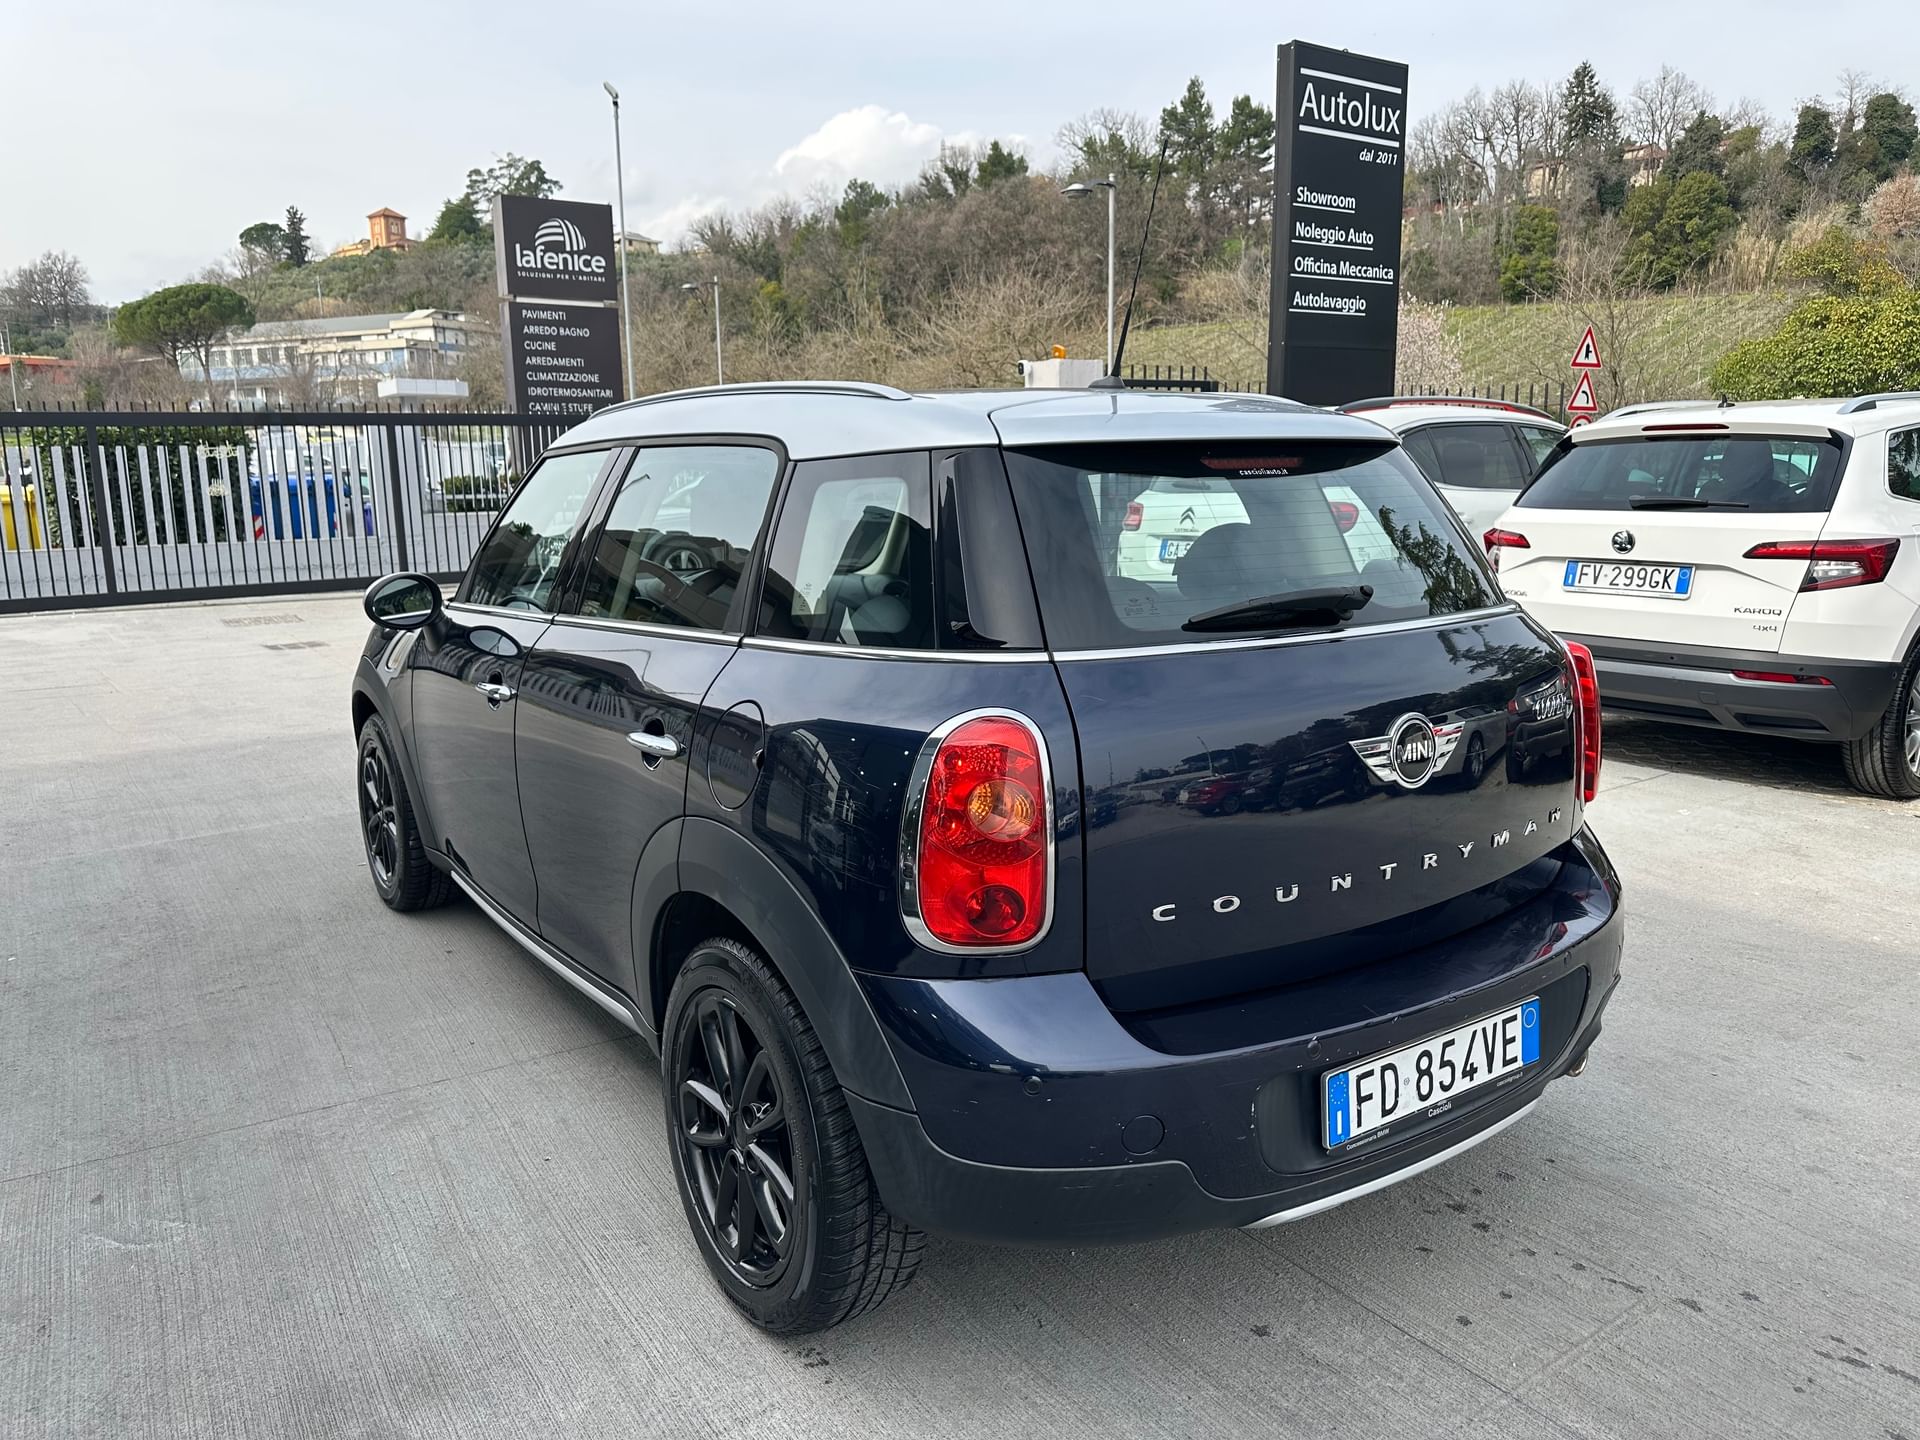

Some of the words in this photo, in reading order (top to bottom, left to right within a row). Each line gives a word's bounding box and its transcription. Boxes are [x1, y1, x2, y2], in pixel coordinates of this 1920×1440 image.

[1300, 82, 1400, 134] Autolux
[1360, 148, 1374, 162] dal
[1376, 152, 1398, 165] 2011
[1297, 186, 1355, 208] Showroom
[1296, 222, 1345, 244] Noleggio
[1348, 228, 1374, 244] Auto
[515, 243, 606, 273] lafenice
[517, 271, 554, 279] SOLUZIONI
[1294, 256, 1336, 274] Officina
[1340, 261, 1393, 279] Meccanica
[1293, 291, 1366, 312] Autolavaggio
[522, 310, 566, 320] PAVIMENTI
[523, 325, 557, 335] ARREDO
[560, 327, 590, 337] BAGNO
[524, 341, 556, 351] CUCINE
[526, 356, 584, 367] ARREDAMENTI
[526, 372, 600, 382] CLIMATIZZAZIONE
[528, 387, 613, 398] IDROTERMOSANITARI
[1578, 564, 1603, 584] FV
[1609, 566, 1676, 590] 299GK
[1734, 608, 1782, 616] KAROQ
[1396, 740, 1433, 764] MINI
[1152, 806, 1560, 922] COUNTRYMAN
[1356, 1062, 1400, 1128] FD
[1415, 1014, 1519, 1102] 854VE
[1428, 1101, 1452, 1117] Cascioli
[1377, 1128, 1390, 1138] BMW
